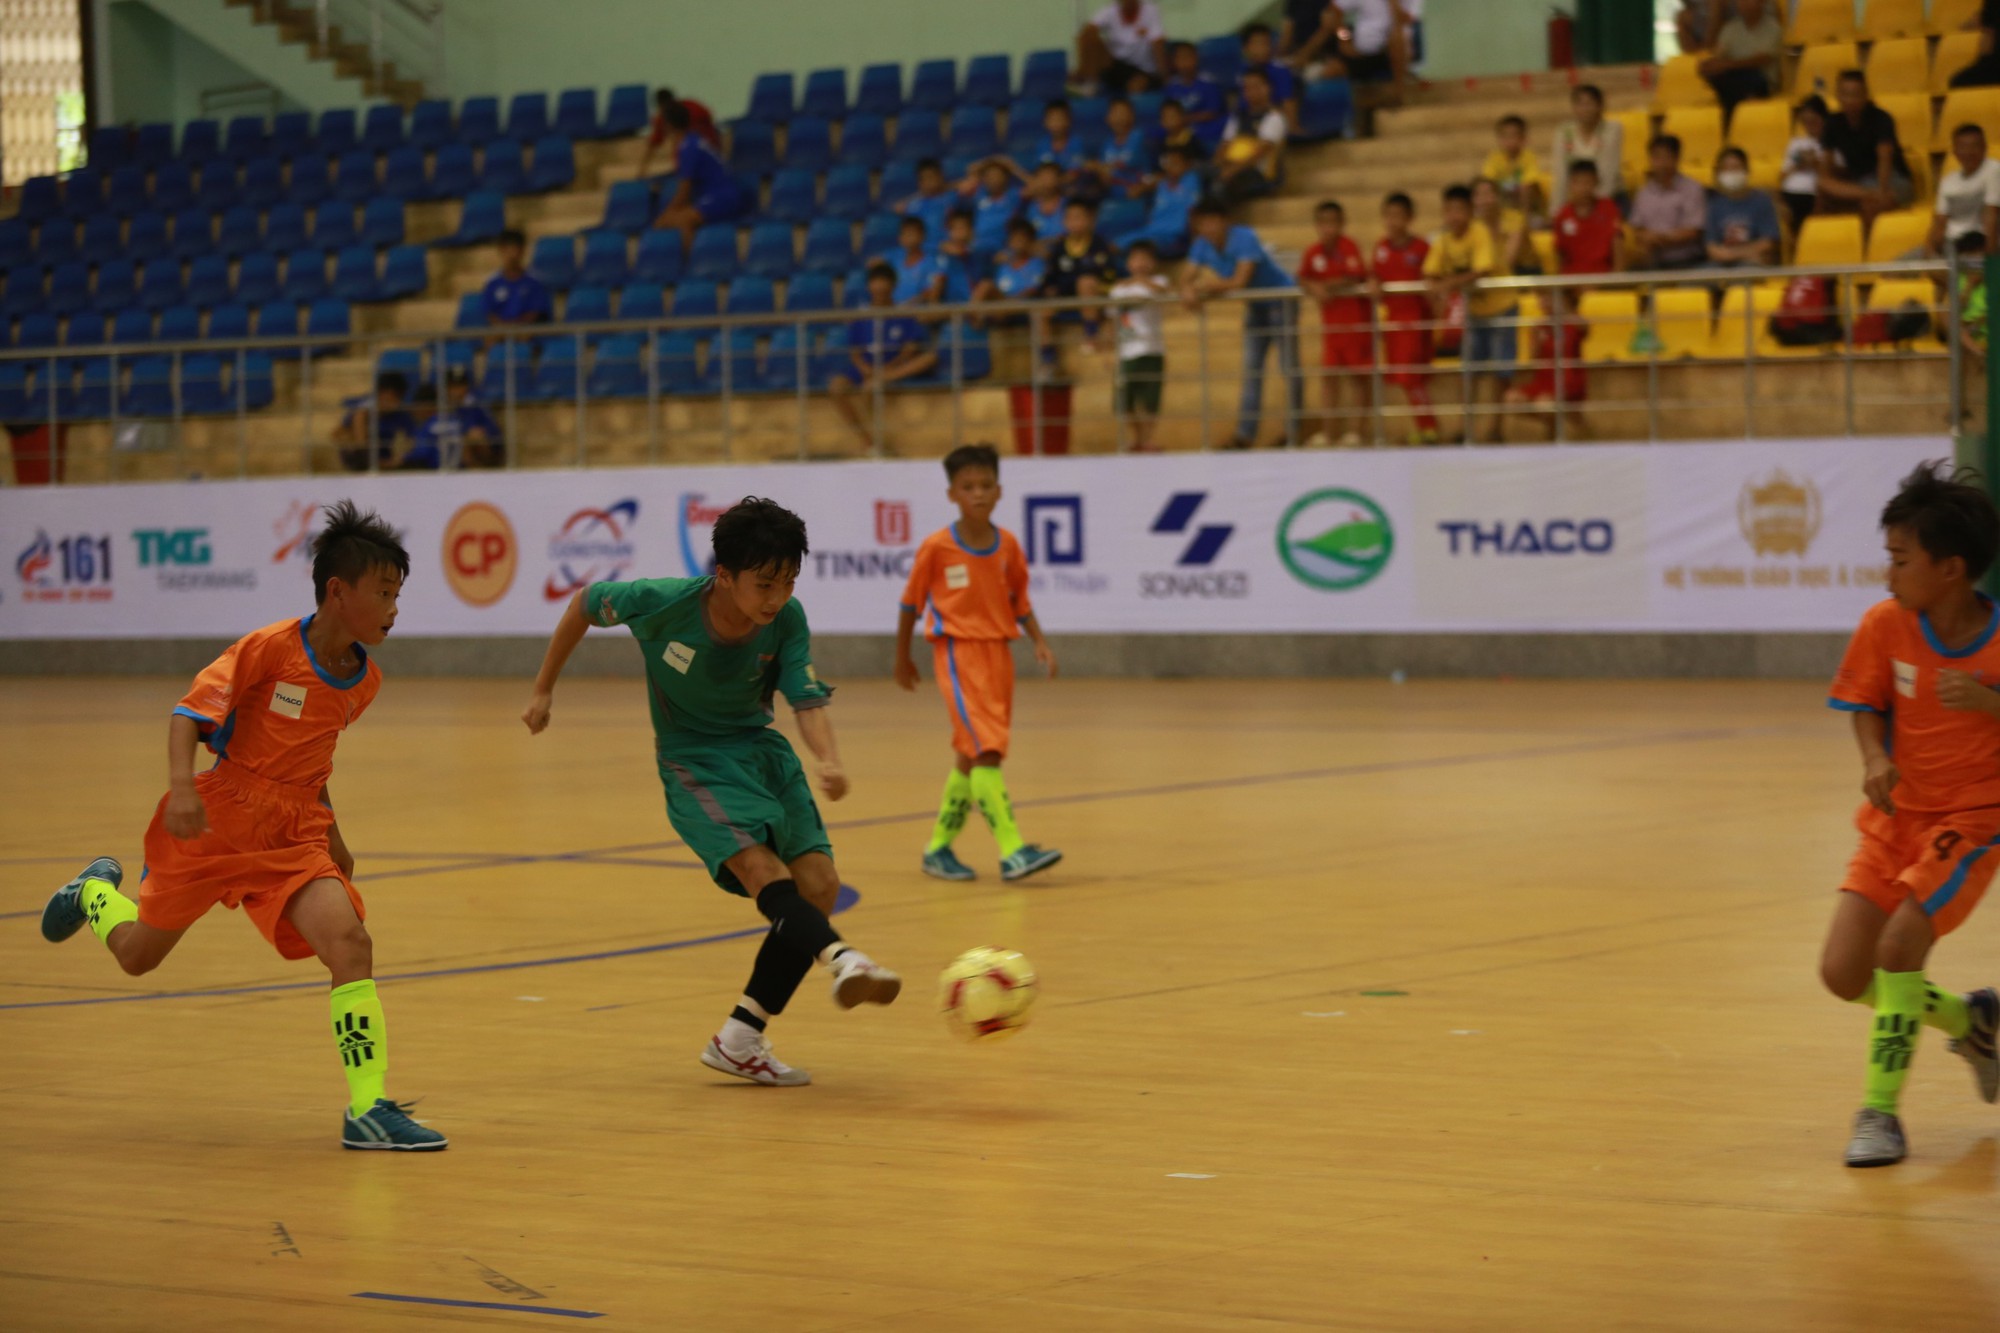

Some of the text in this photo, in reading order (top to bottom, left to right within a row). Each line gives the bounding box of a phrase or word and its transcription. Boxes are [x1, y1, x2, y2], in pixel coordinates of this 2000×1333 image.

[132, 529, 213, 567] TKG
[452, 532, 508, 577] CP
[1438, 520, 1615, 555] THACO
[58, 534, 112, 584] 161
[274, 692, 303, 707] THACO
[1934, 829, 1962, 861] 9
